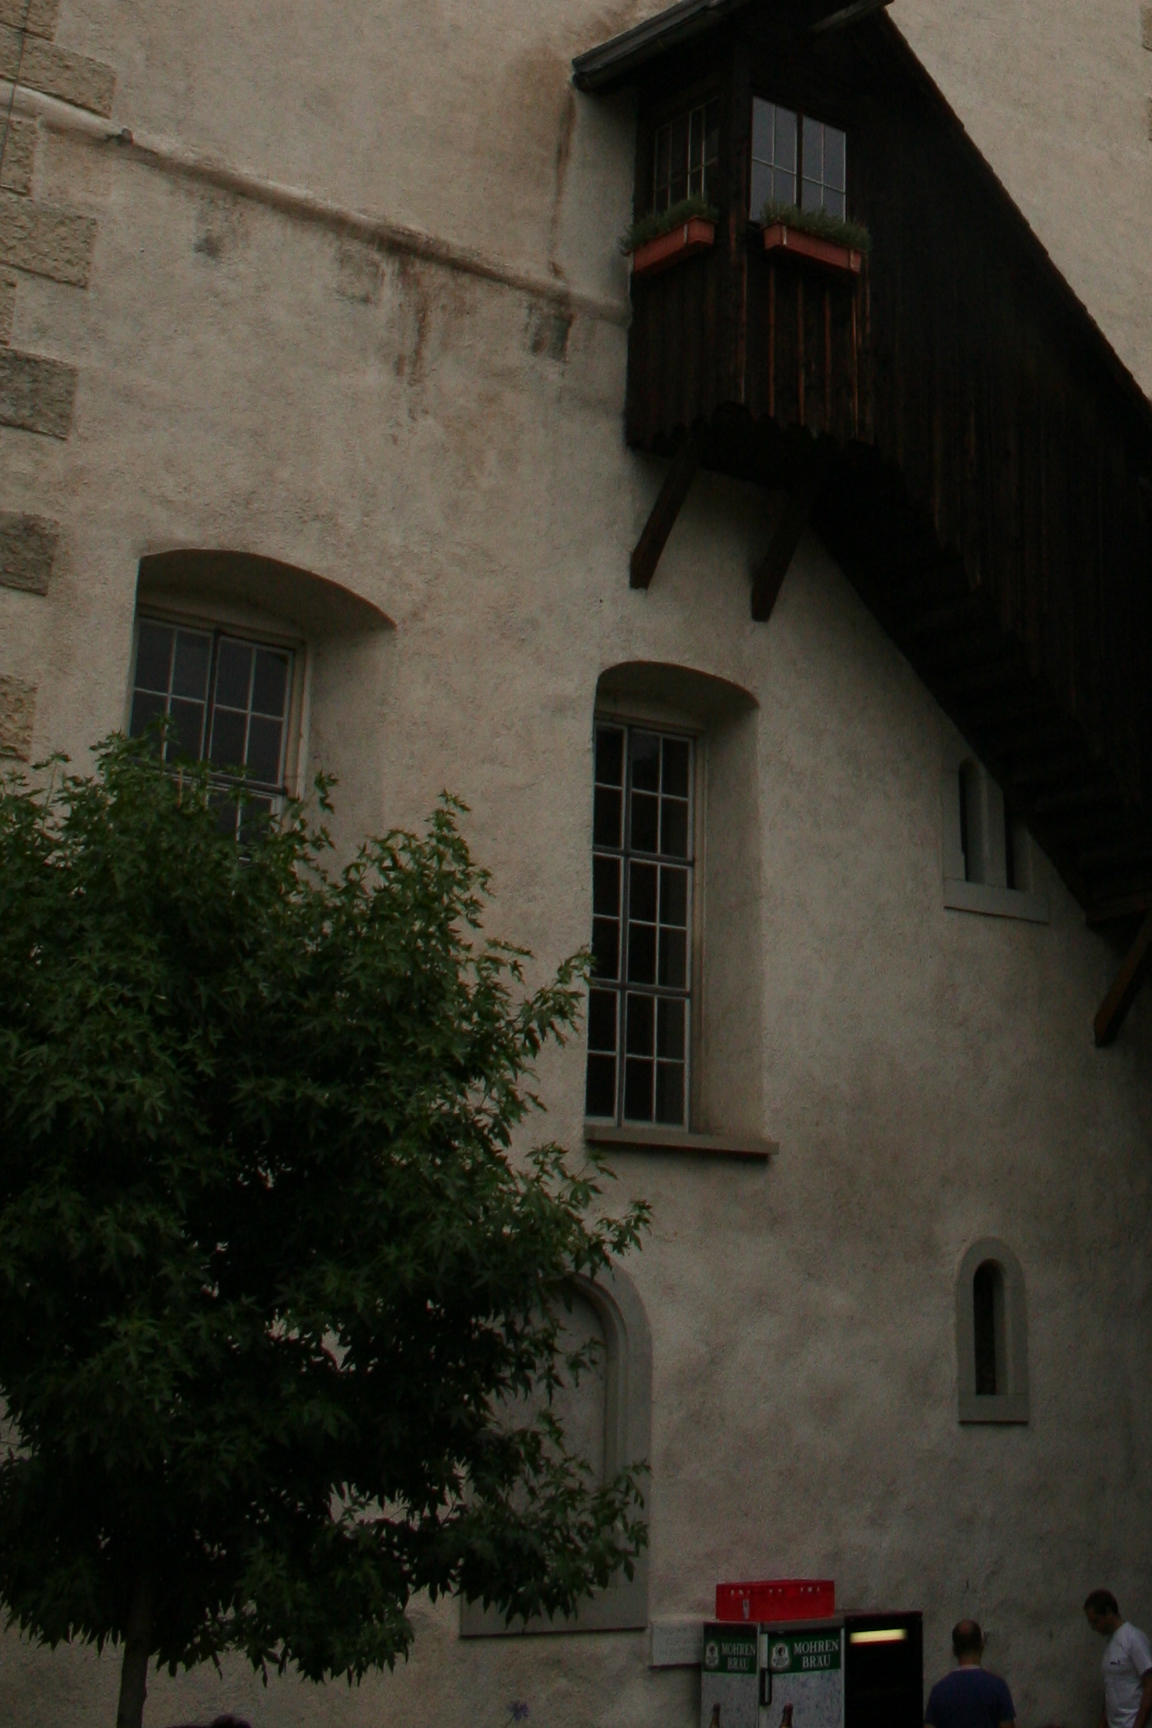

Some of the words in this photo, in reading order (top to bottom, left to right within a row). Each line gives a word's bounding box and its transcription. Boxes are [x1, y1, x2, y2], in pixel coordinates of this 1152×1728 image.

[722, 1643, 756, 1656] MOHREN
[794, 1639, 839, 1654] MOHREN
[802, 1654, 831, 1668] BRÄU
